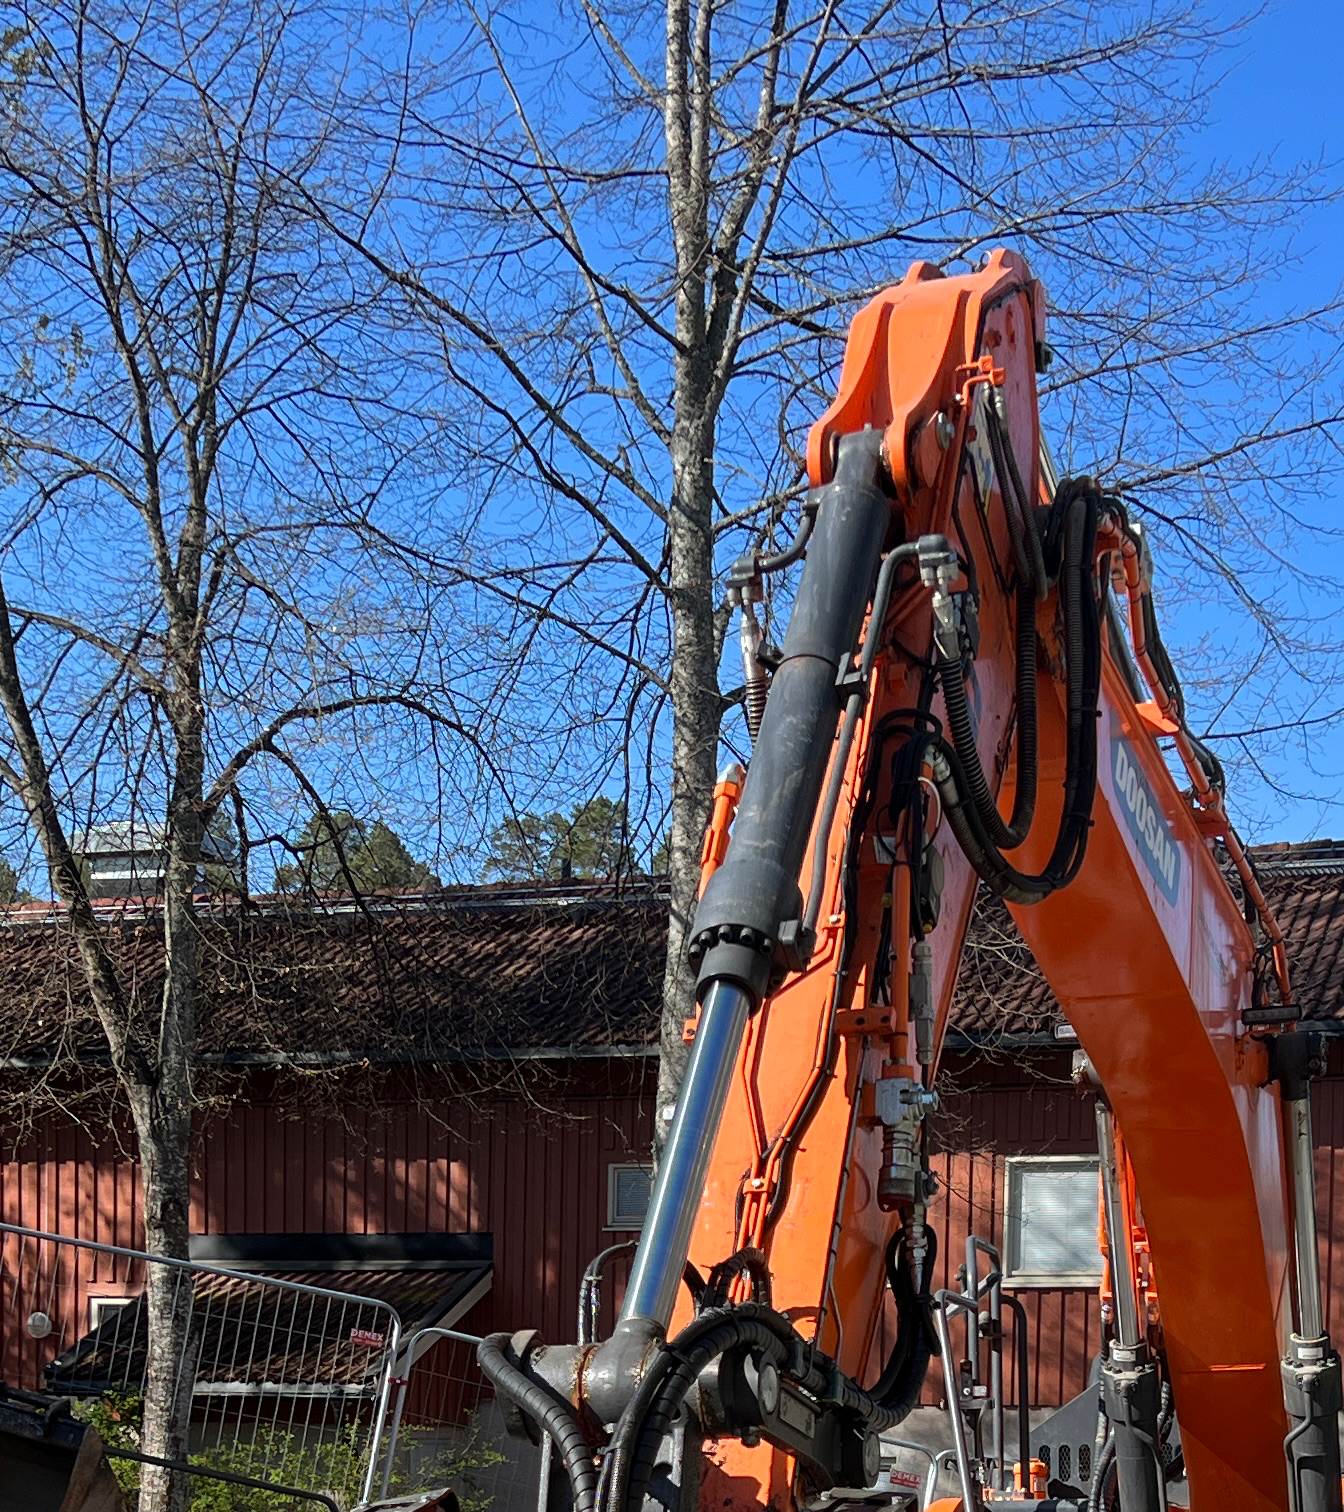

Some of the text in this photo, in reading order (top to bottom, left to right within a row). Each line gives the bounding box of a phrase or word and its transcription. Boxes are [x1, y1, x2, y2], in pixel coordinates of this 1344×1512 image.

[1115, 741, 1176, 891] DOOSAN
[351, 1328, 384, 1341] DEMEX
[891, 1470, 921, 1483] DEMEX
